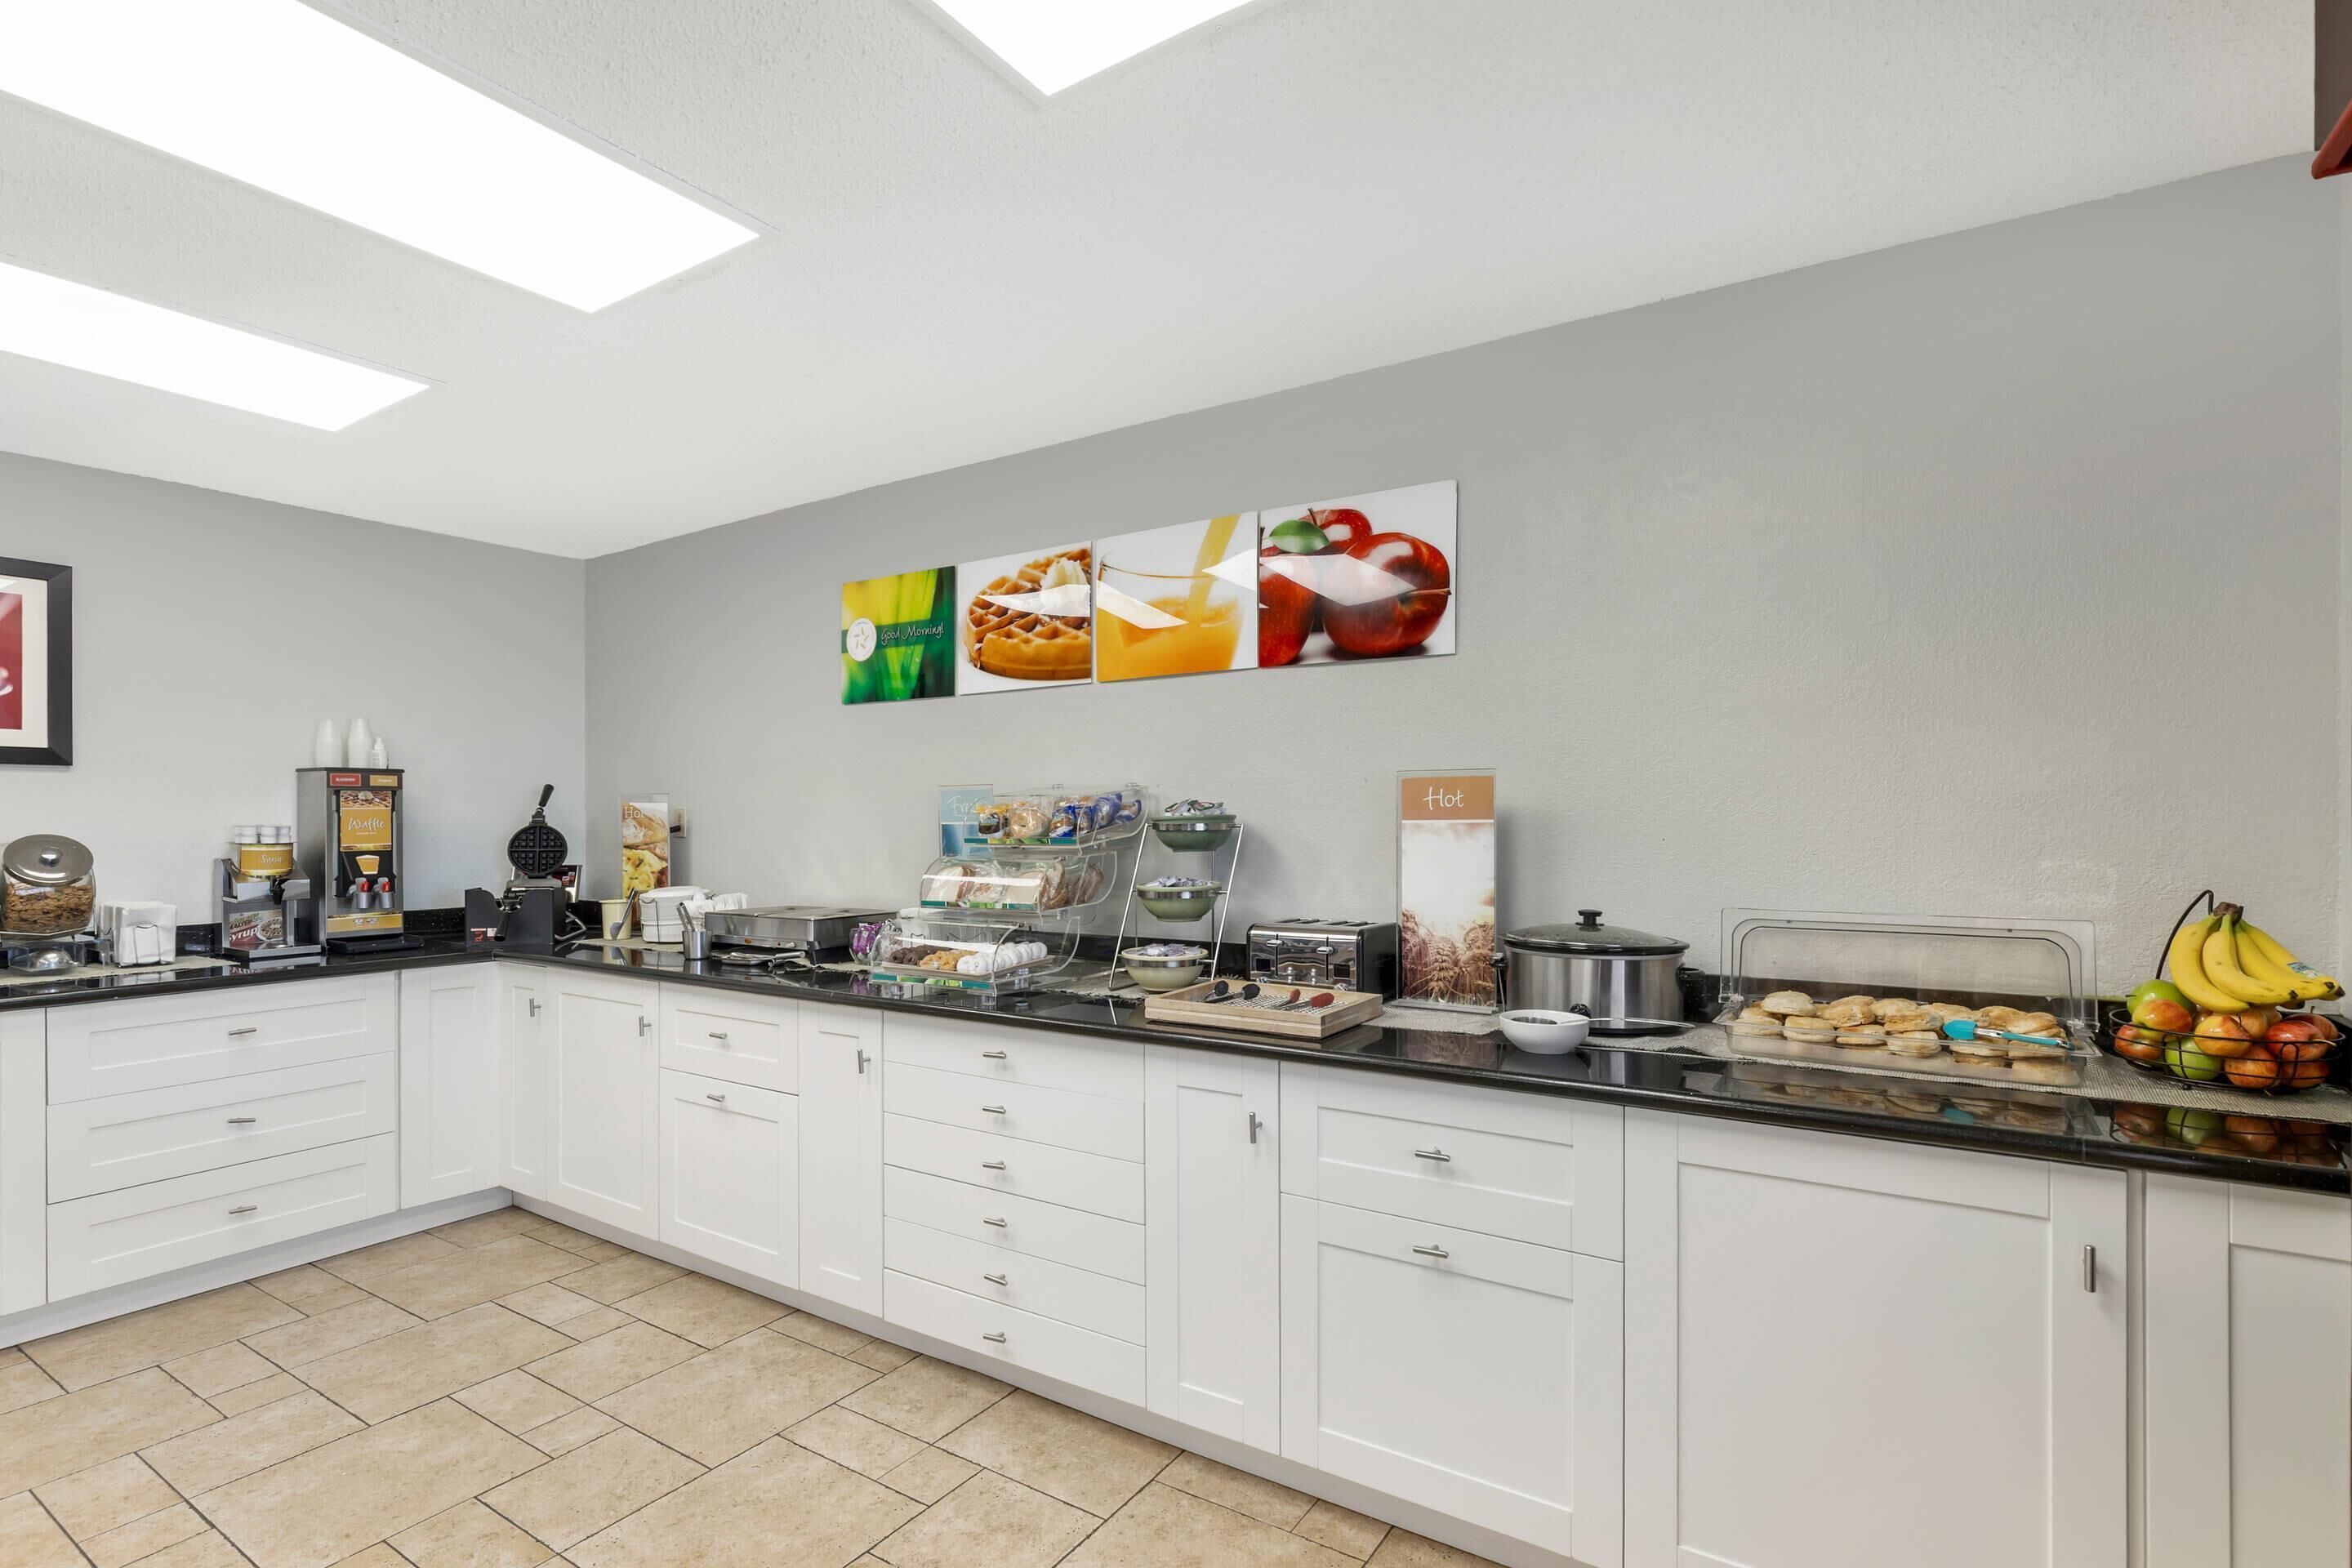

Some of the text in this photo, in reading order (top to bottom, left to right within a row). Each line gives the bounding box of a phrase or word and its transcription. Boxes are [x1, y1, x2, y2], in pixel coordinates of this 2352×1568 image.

[881, 622, 944, 646] Good Morning!
[1423, 786, 1464, 810] Hot
[624, 806, 646, 818] Hot
[348, 817, 385, 831] Waffle
[261, 854, 284, 866] Syrup
